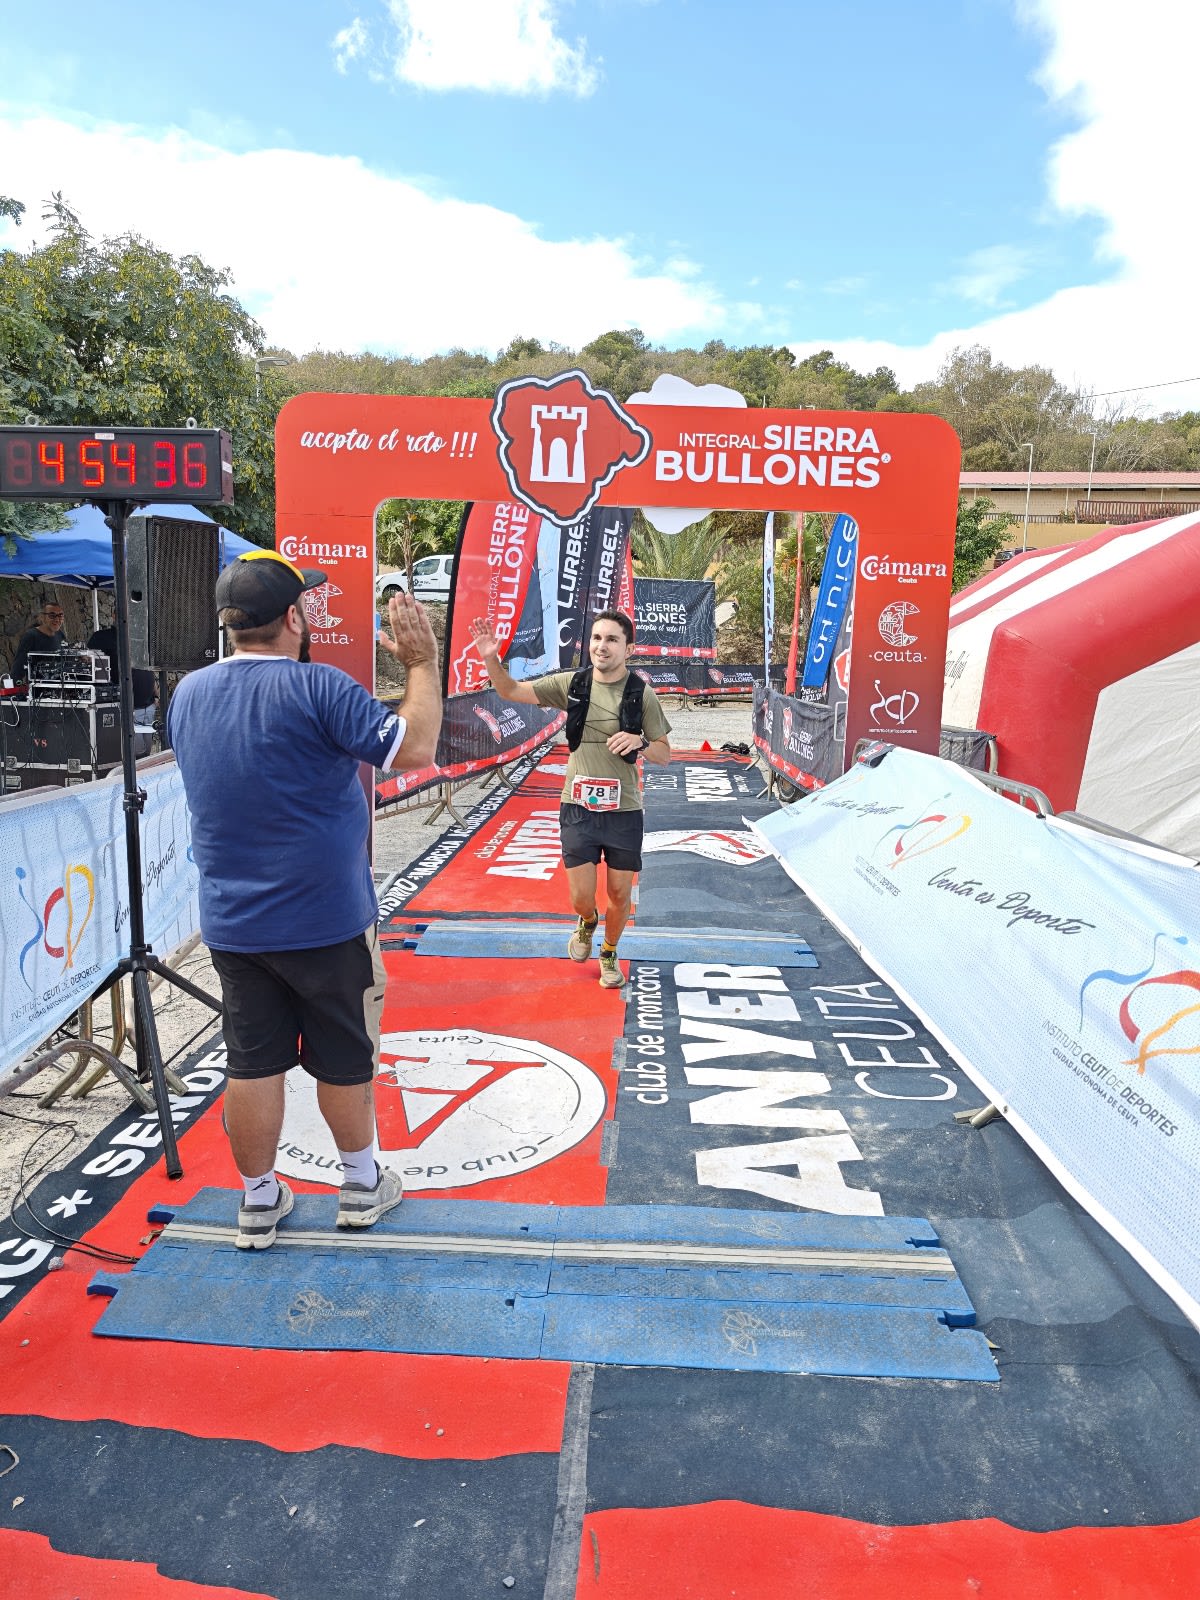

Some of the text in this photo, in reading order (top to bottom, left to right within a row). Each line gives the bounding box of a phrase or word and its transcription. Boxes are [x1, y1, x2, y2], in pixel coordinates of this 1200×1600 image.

[300, 428, 373, 455] acepta
[378, 428, 400, 451] el
[406, 431, 447, 454] reto
[679, 424, 881, 454] INTEGRAL SIERRA
[655, 449, 881, 489] BULLONES
[488, 502, 513, 568] SIERR
[494, 502, 530, 640] BULLONE
[557, 518, 585, 610] LURBE
[897, 576, 918, 584] Ceuta
[633, 611, 687, 625] LONES
[645, 602, 686, 613] SIERRA
[309, 632, 350, 645] euta
[585, 786, 605, 798] 78
[413, 839, 465, 879] MARCHA
[927, 866, 1097, 935] Ceuta es Deporte
[418, 1035, 484, 1045] Ceuta
[624, 965, 669, 1106] club de montaña
[810, 981, 958, 1101] CEUTA
[1041, 1019, 1083, 1058] INSTITUTO
[1105, 1074, 1125, 1093] DE
[1119, 1085, 1179, 1138] DEPORTES
[1051, 1047, 1075, 1070] CIUDAD
[1106, 1096, 1119, 1110] DE
[1117, 1104, 1140, 1128] CEUTA
[403, 1163, 449, 1178] de
[461, 1144, 539, 1173] Club
